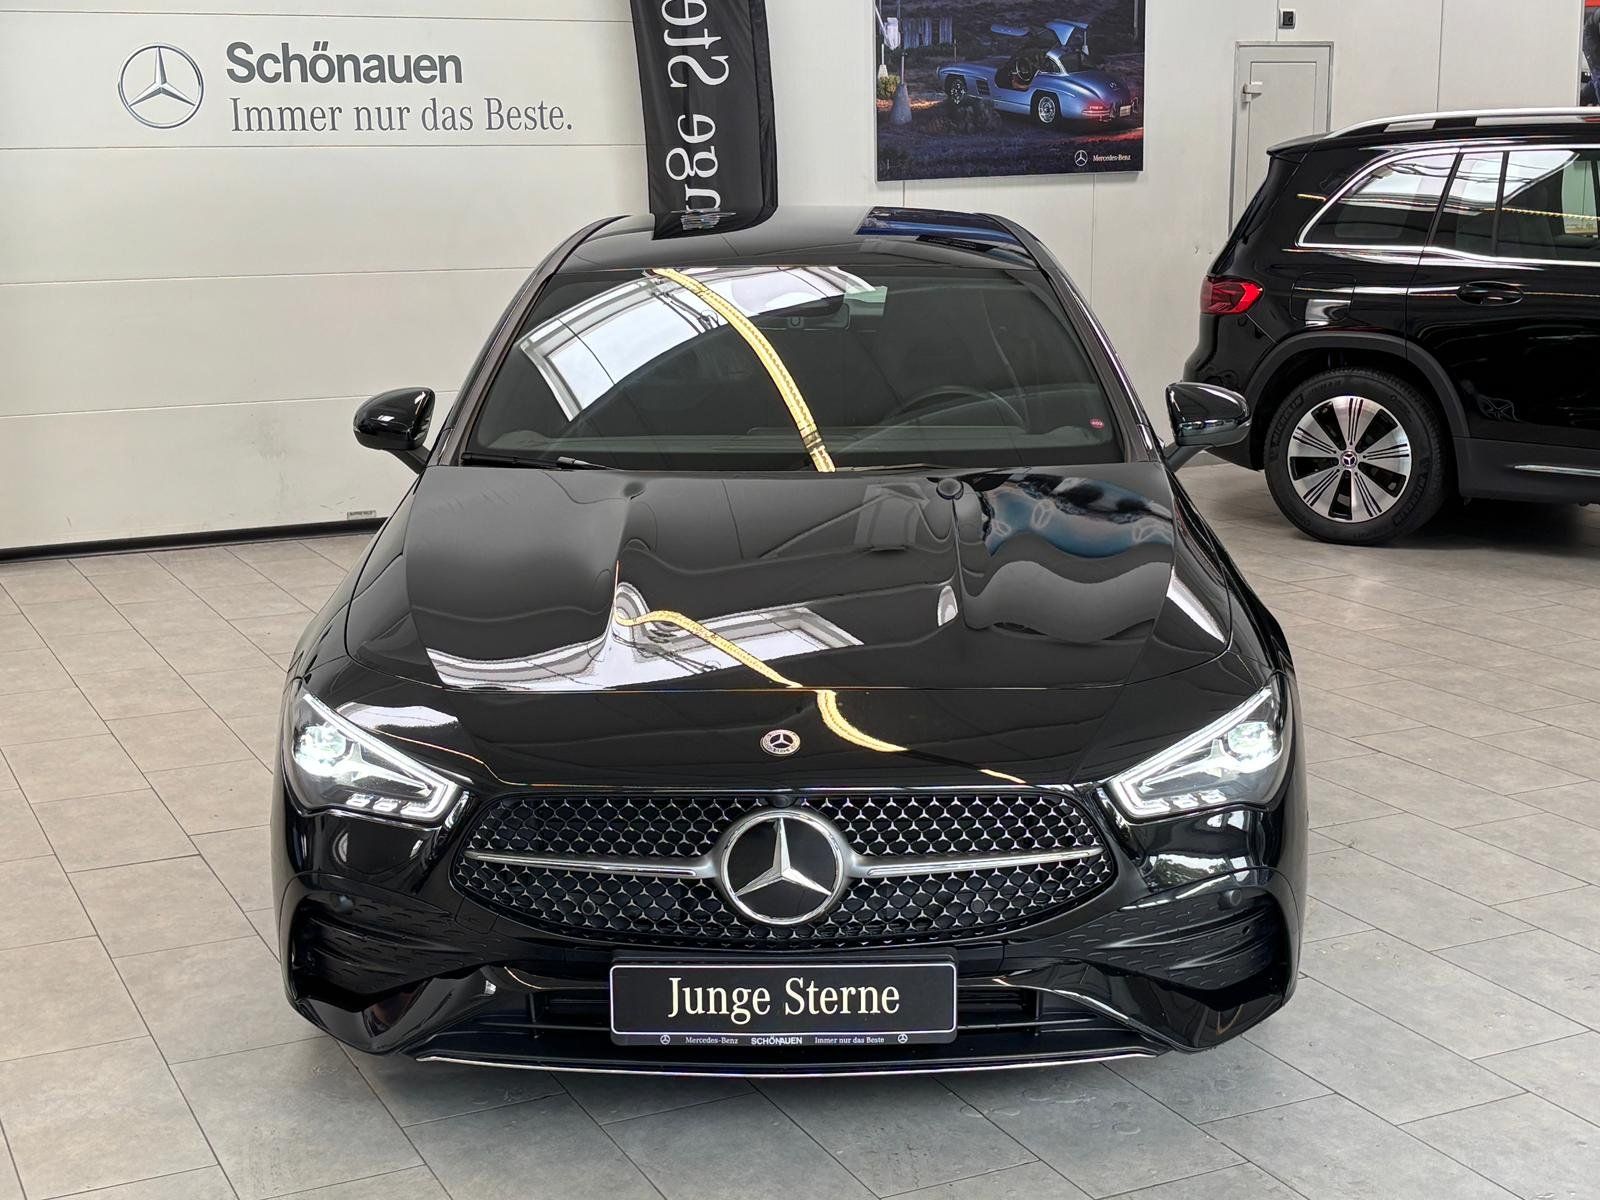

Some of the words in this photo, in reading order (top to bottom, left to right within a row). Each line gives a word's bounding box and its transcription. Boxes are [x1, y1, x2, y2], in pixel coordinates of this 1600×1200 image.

[226, 40, 463, 84] Schönauen
[230, 97, 343, 133] Immer
[353, 101, 410, 132] nur
[421, 97, 474, 130] das
[484, 97, 573, 131] Beste.
[1092, 154, 1132, 162] Mercedes-Benz
[667, 977, 771, 1025] Junge
[784, 977, 900, 1016] Sterne
[685, 1036, 739, 1045] Mercedes-Benz
[750, 1034, 803, 1046] SCHÖNAUEN
[814, 1036, 838, 1044] Immer
[852, 1036, 865, 1044] das
